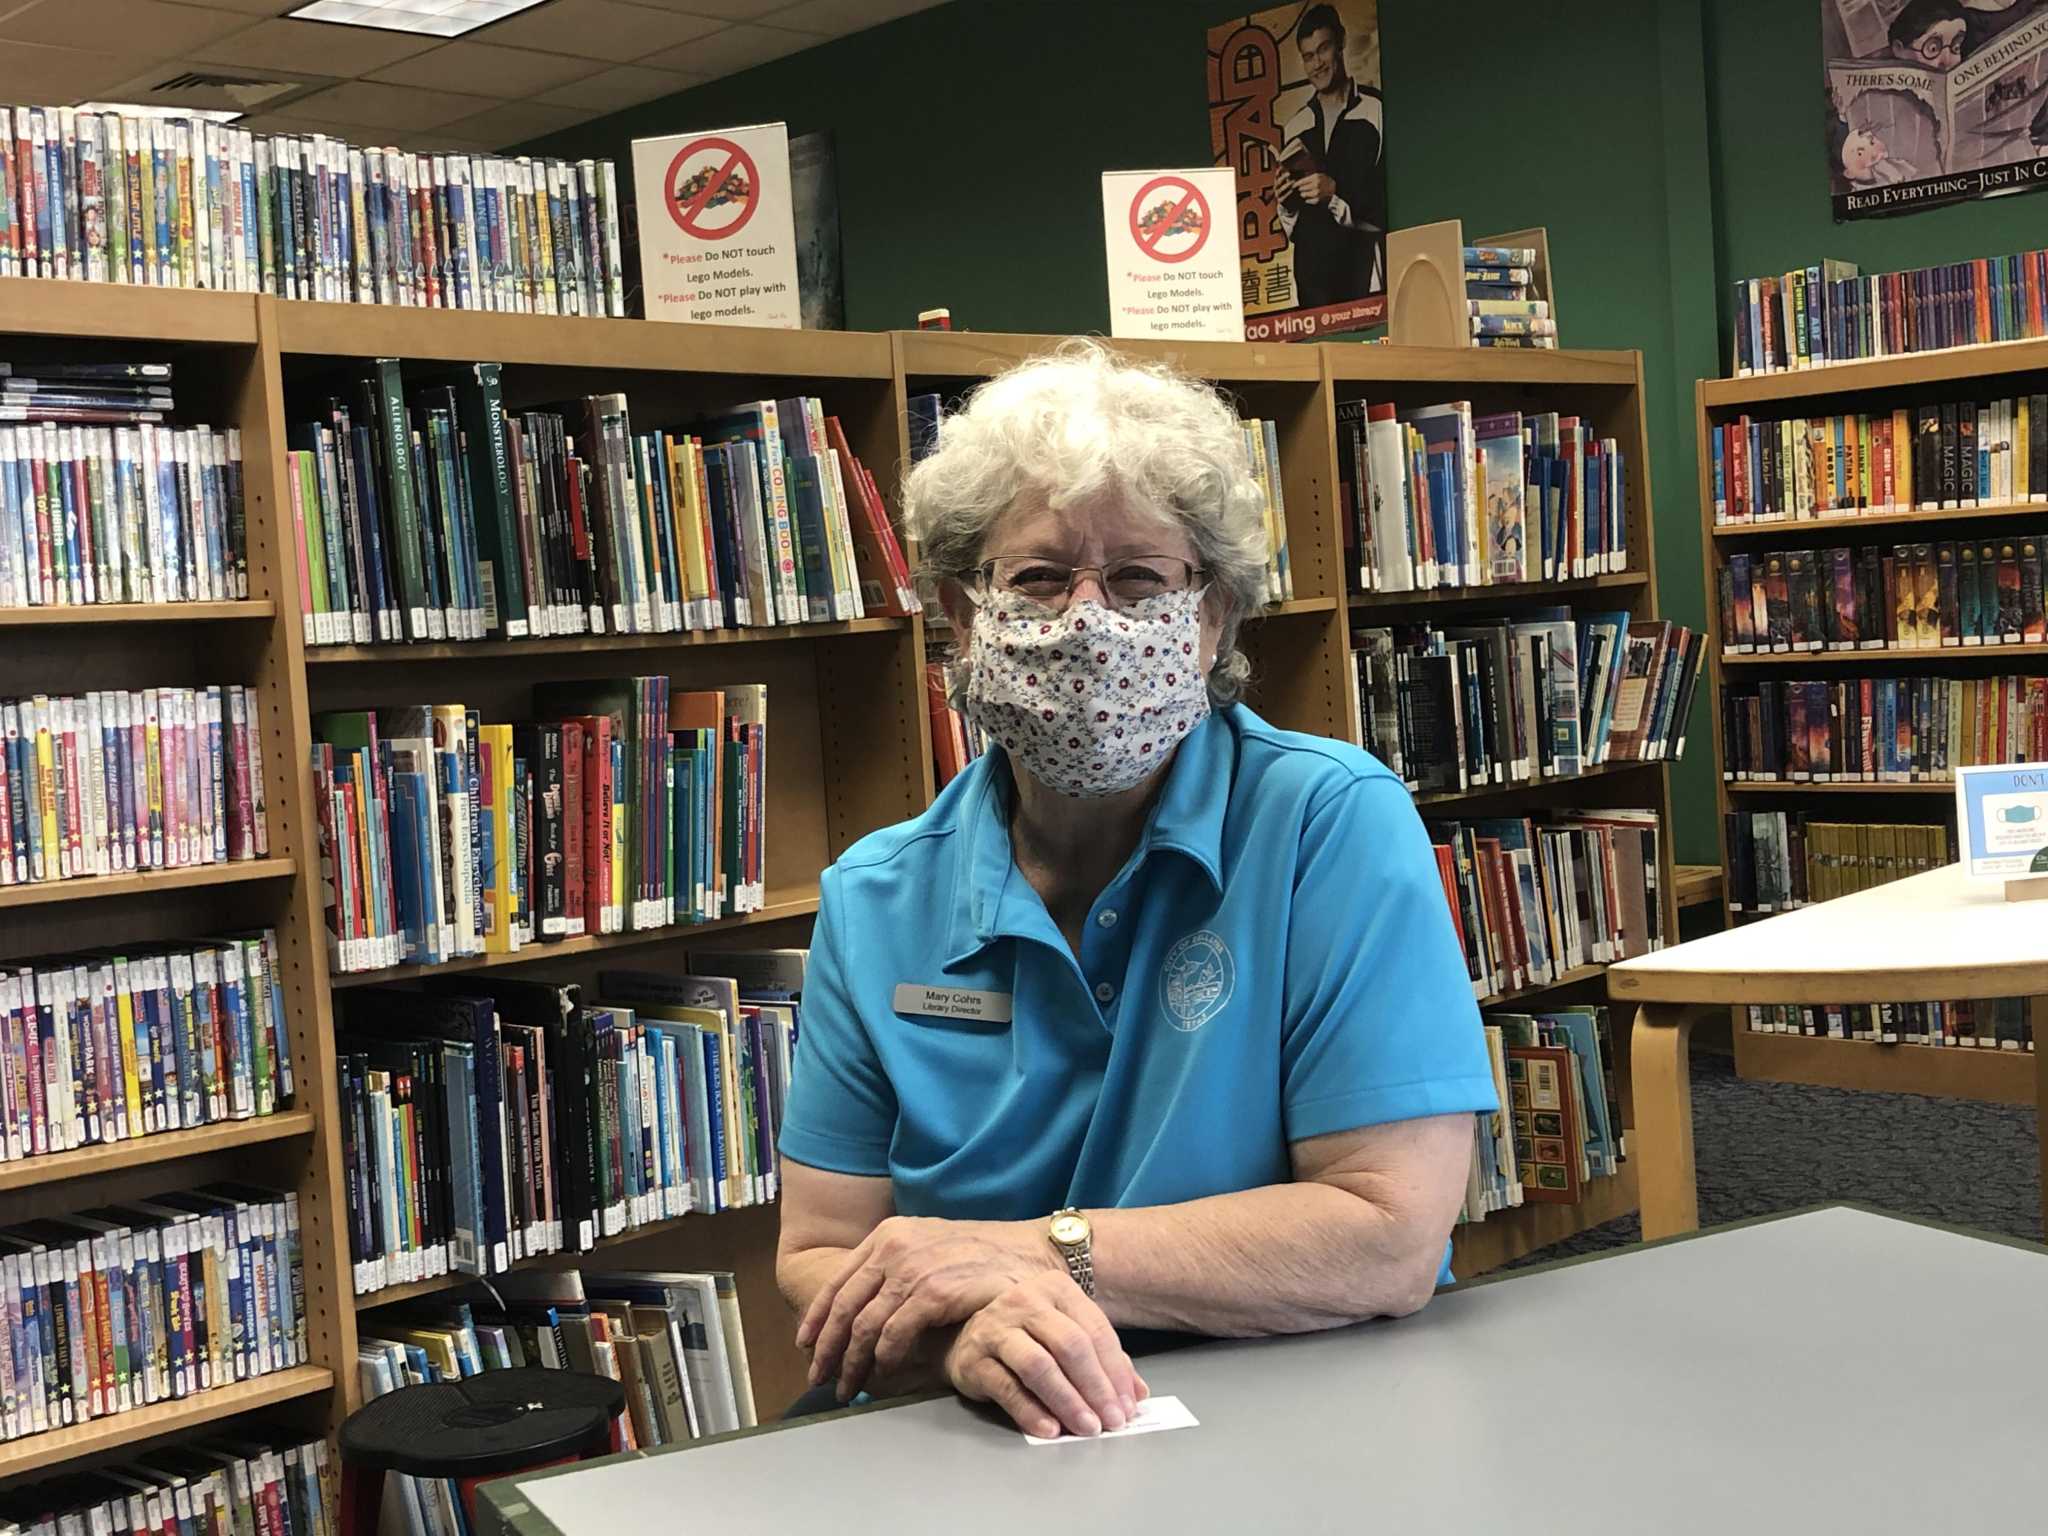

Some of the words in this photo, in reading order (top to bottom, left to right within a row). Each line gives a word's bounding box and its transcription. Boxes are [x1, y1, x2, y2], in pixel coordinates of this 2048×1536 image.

[1846, 74, 1894, 87] THERE'S
[1896, 74, 1935, 90] SOME
[1953, 65, 1984, 87] ONE
[1983, 31, 2033, 69] BEHIND
[1220, 25, 1288, 263] READ
[2033, 161, 2048, 177] C
[456, 223, 466, 249] STAR
[704, 251, 720, 261] Do
[722, 248, 744, 259] NOT
[746, 245, 776, 257] touch
[686, 272, 710, 284] Lego
[713, 267, 754, 279] Models.
[1163, 272, 1176, 281] Do
[1177, 271, 1197, 280] NOT
[1199, 270, 1224, 279] touch
[698, 290, 712, 300] Do
[714, 287, 736, 298] NOT
[739, 285, 761, 298] play
[763, 282, 786, 293] with
[1147, 290, 1168, 300] Lego
[1170, 288, 1204, 298] Models.
[691, 309, 711, 321] lego
[714, 305, 755, 317] models.
[1157, 305, 1169, 314] Do
[1171, 304, 1190, 313] NOT
[1192, 303, 1211, 313] play
[1212, 302, 1233, 311] with
[1244, 323, 1269, 339] ao
[1274, 316, 1316, 335] Ming
[1352, 303, 1383, 318] library
[1150, 321, 1169, 330] lego
[1171, 319, 1206, 329] models.
[390, 396, 407, 471] ALIENOLOGY
[768, 430, 776, 444] My
[489, 399, 509, 496] MONSTEROLOGY
[1943, 445, 1954, 491] MAGIC
[1961, 445, 1973, 492] MAGIC
[771, 469, 787, 518] CODING
[50, 498, 63, 546] FLUBBER
[778, 521, 790, 557] BOOK
[548, 768, 556, 781] The
[460, 797, 471, 824] First
[468, 777, 481, 845] Children's
[602, 784, 610, 818] Believe
[603, 820, 611, 829] It
[603, 831, 609, 841] or
[461, 825, 473, 905] Encyclopedia
[603, 842, 611, 863] Not!
[470, 847, 483, 929] Encyclopedia
[922, 1002, 949, 1014] Library
[951, 1005, 982, 1015] Director
[926, 991, 950, 1003] Mary
[952, 993, 982, 1005] Cohrs
[85, 1047, 95, 1075] PARK
[530, 1092, 539, 1107] The
[531, 1109, 540, 1136] Salem
[533, 1138, 541, 1162] Witch
[535, 1164, 543, 1190] Trials
